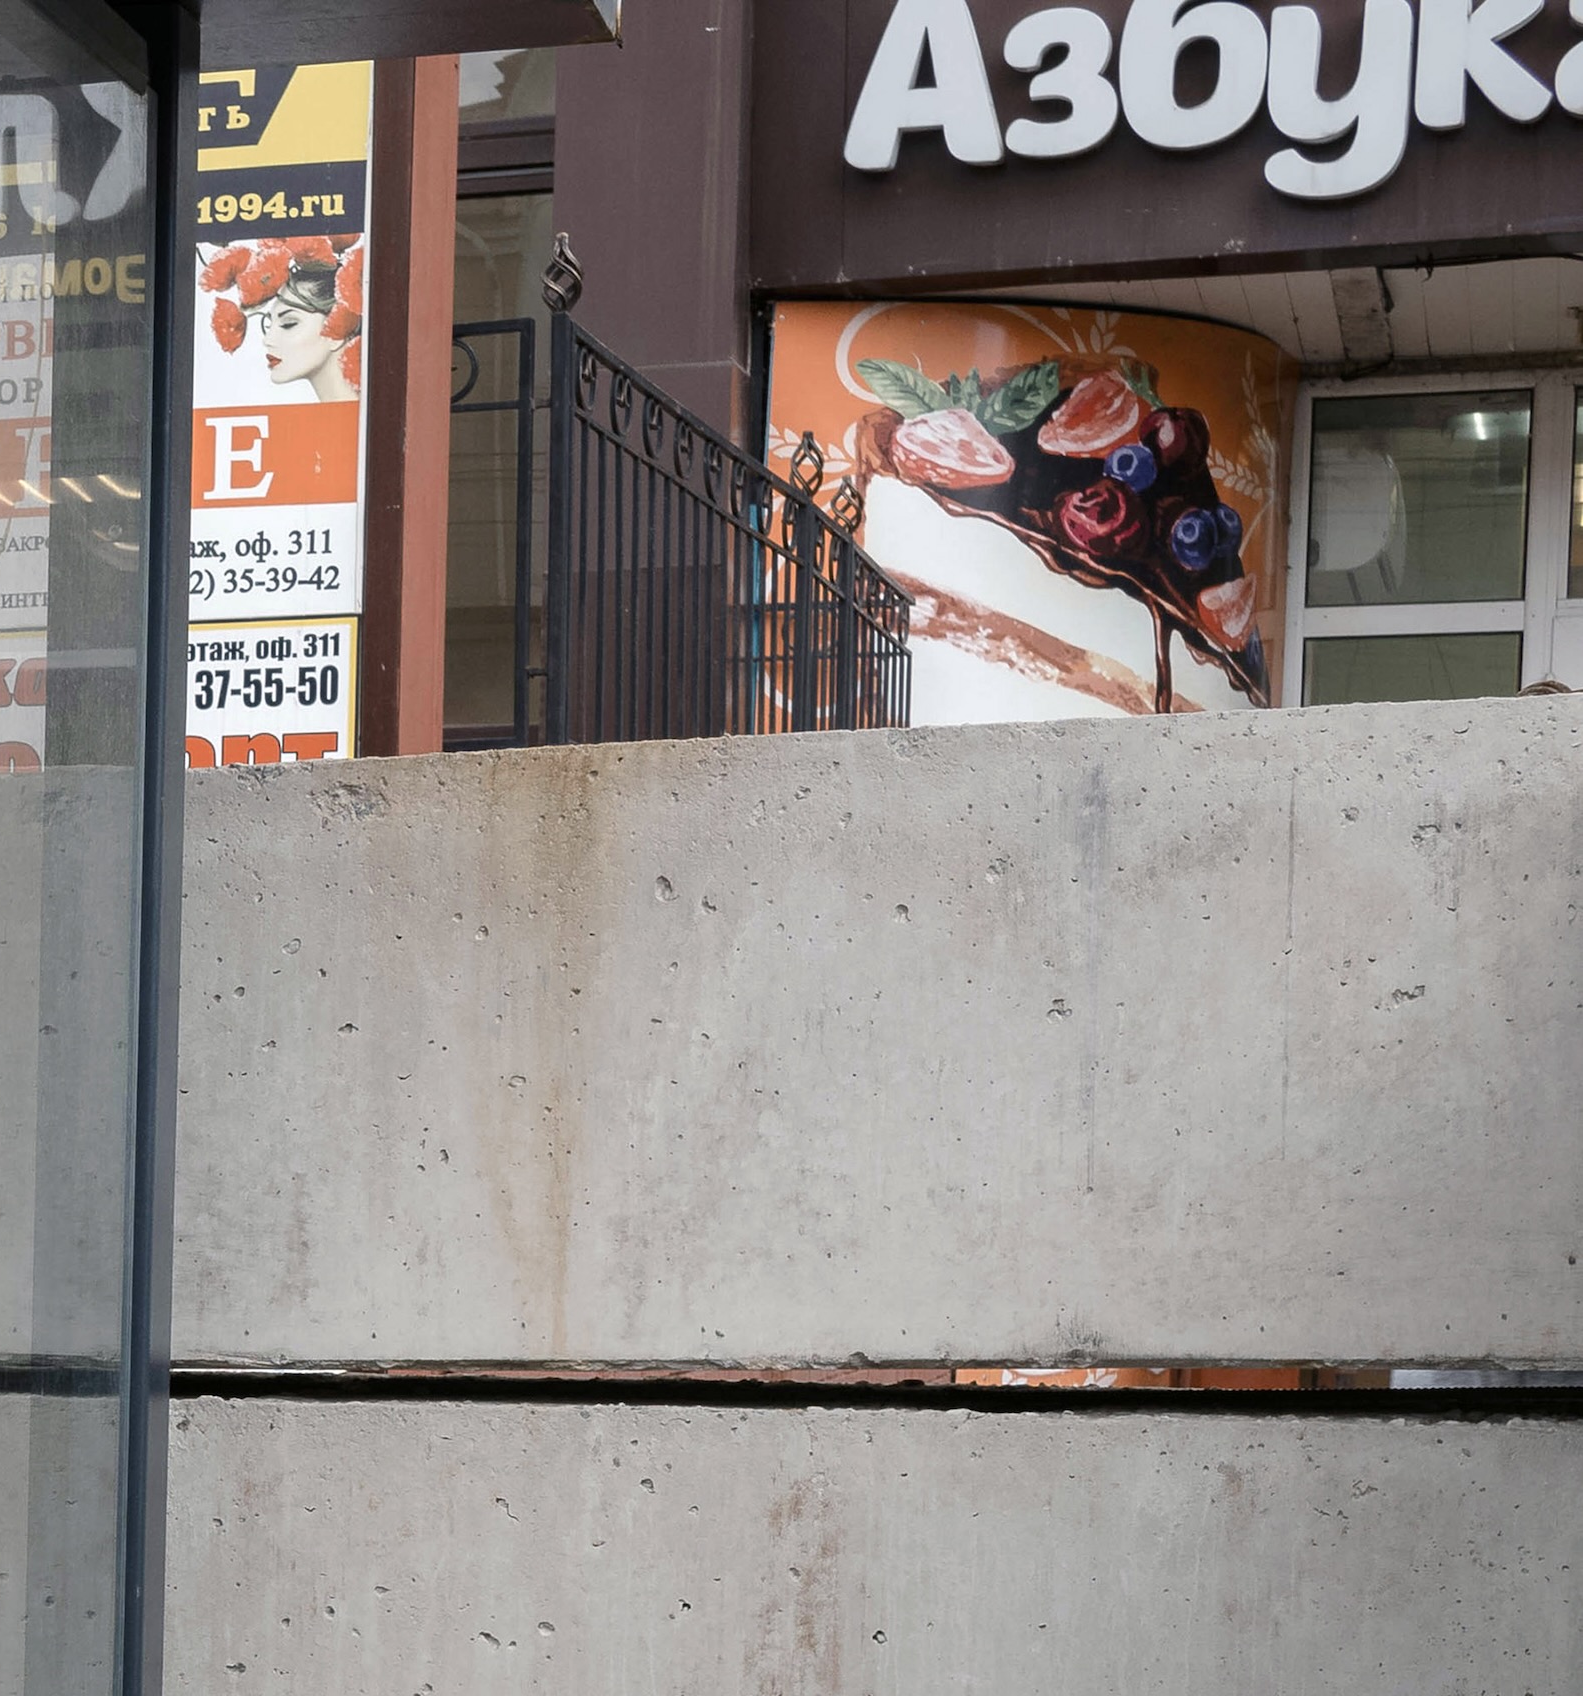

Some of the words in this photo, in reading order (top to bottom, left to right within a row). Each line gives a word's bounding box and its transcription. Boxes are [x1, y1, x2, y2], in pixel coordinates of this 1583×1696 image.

[844, 0, 1583, 199] Азбук
[235, 531, 278, 563] оф.
[288, 529, 332, 555] 311
[223, 566, 340, 593] 35-39-42
[255, 636, 297, 661] оф.
[303, 632, 340, 657] 311
[195, 665, 339, 710] 37-55-50
